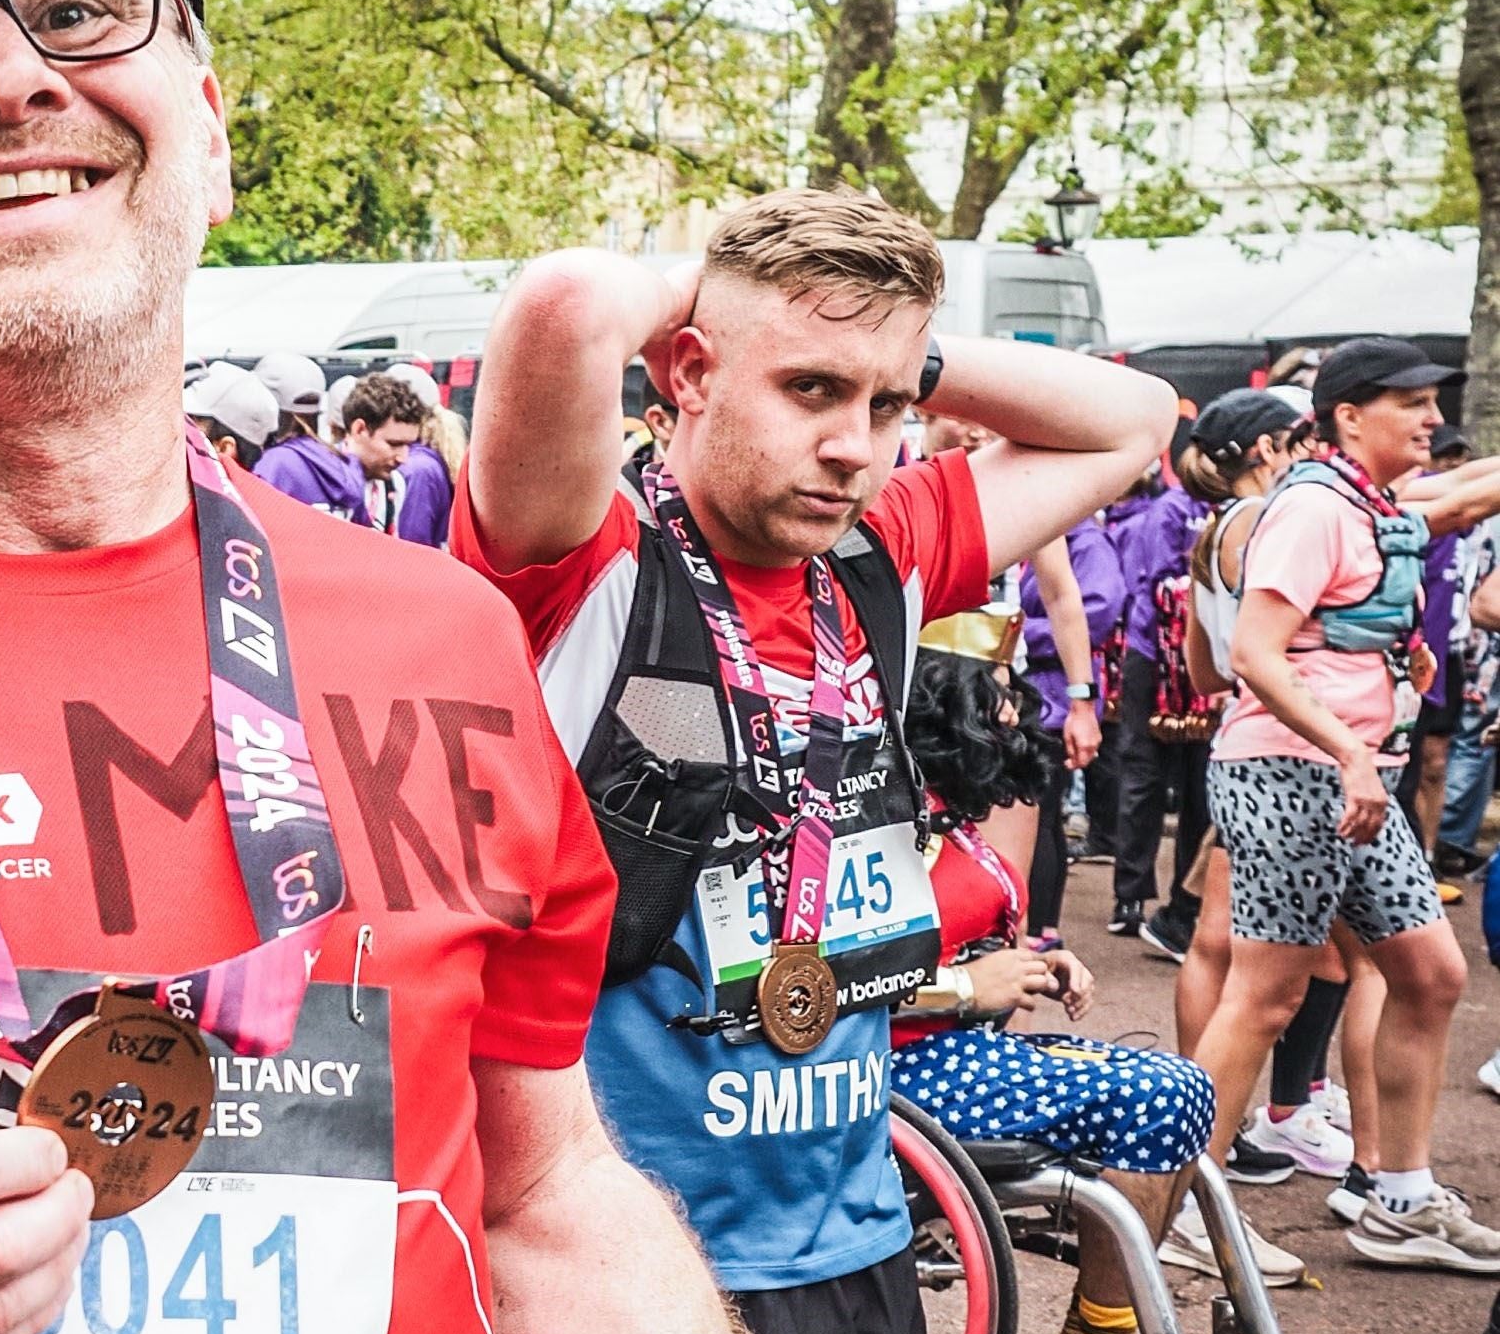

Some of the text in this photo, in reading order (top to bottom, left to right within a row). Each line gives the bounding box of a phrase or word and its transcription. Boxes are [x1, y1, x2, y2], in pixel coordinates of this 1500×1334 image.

[225, 538, 264, 602] tcs
[714, 609, 755, 689] FINISHER
[748, 712, 771, 753] tcs
[230, 714, 307, 834] 2024
[62, 689, 533, 937] MKE
[272, 849, 321, 922] tcs
[797, 877, 821, 916] tcs
[209, 1055, 362, 1098] LTANCY
[703, 1049, 888, 1138] SMITHY
